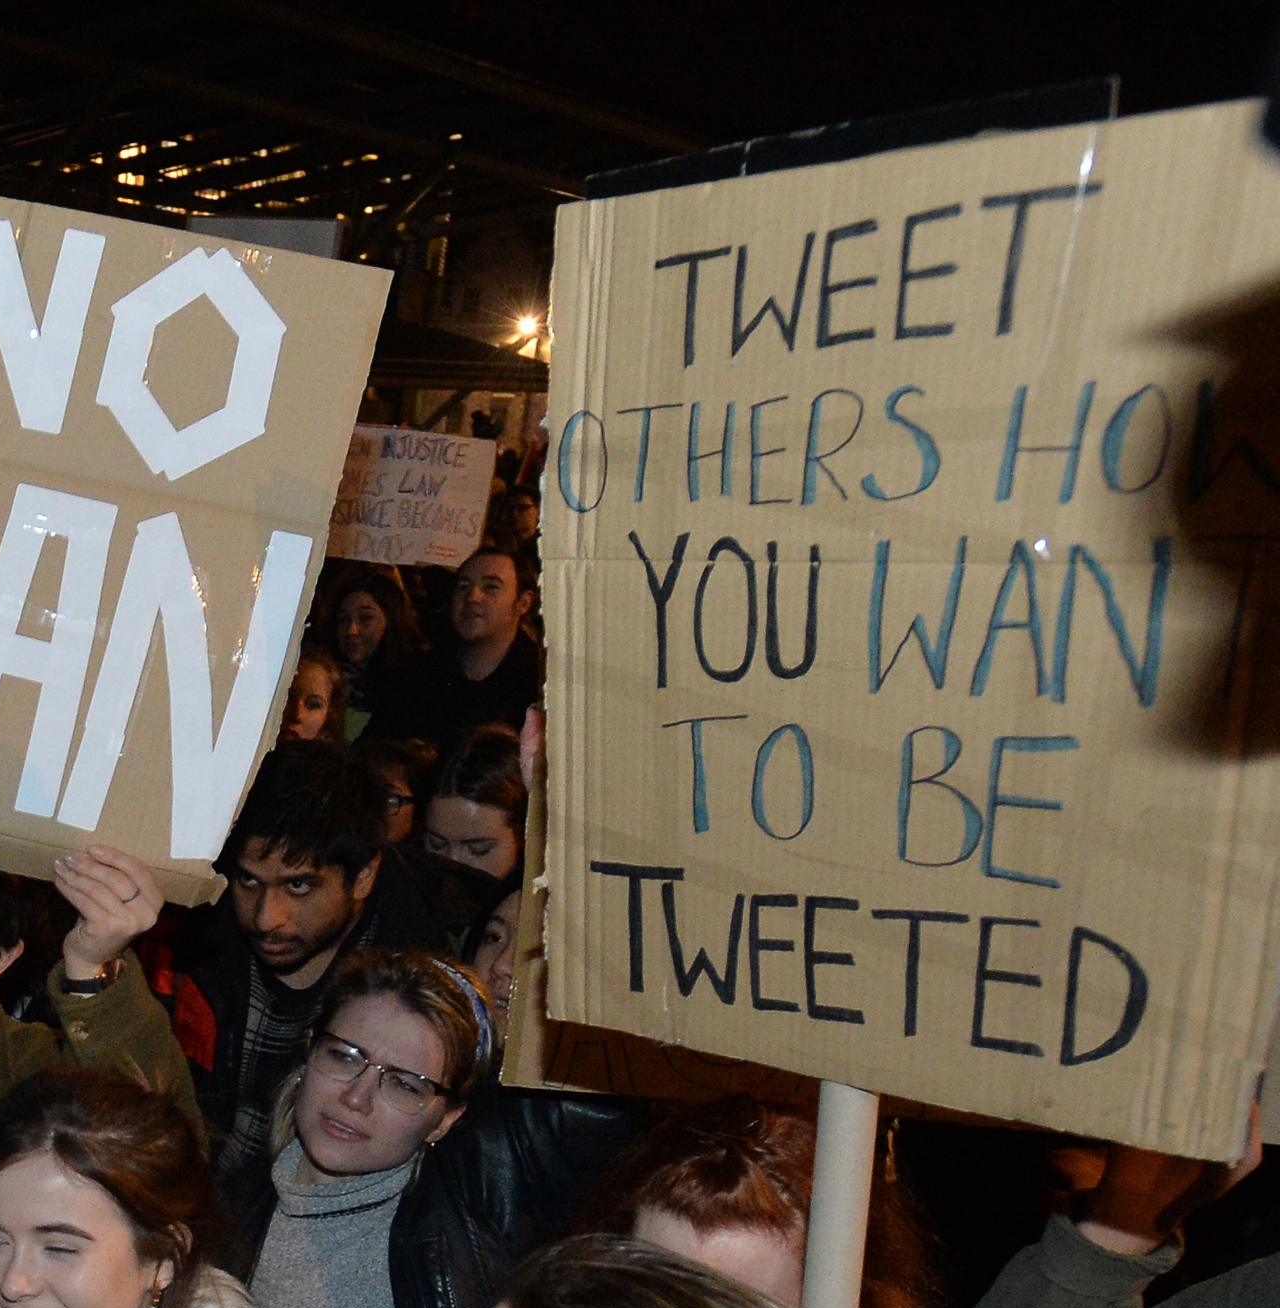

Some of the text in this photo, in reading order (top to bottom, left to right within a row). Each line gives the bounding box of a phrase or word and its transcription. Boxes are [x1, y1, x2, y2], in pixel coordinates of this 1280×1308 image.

[655, 183, 1102, 369] TWEET
[398, 468, 447, 498] LAW
[557, 386, 941, 513] OTHERS
[628, 531, 820, 690] YOU
[662, 713, 1080, 890] TO BE
[589, 860, 1151, 1068] TWEETED
